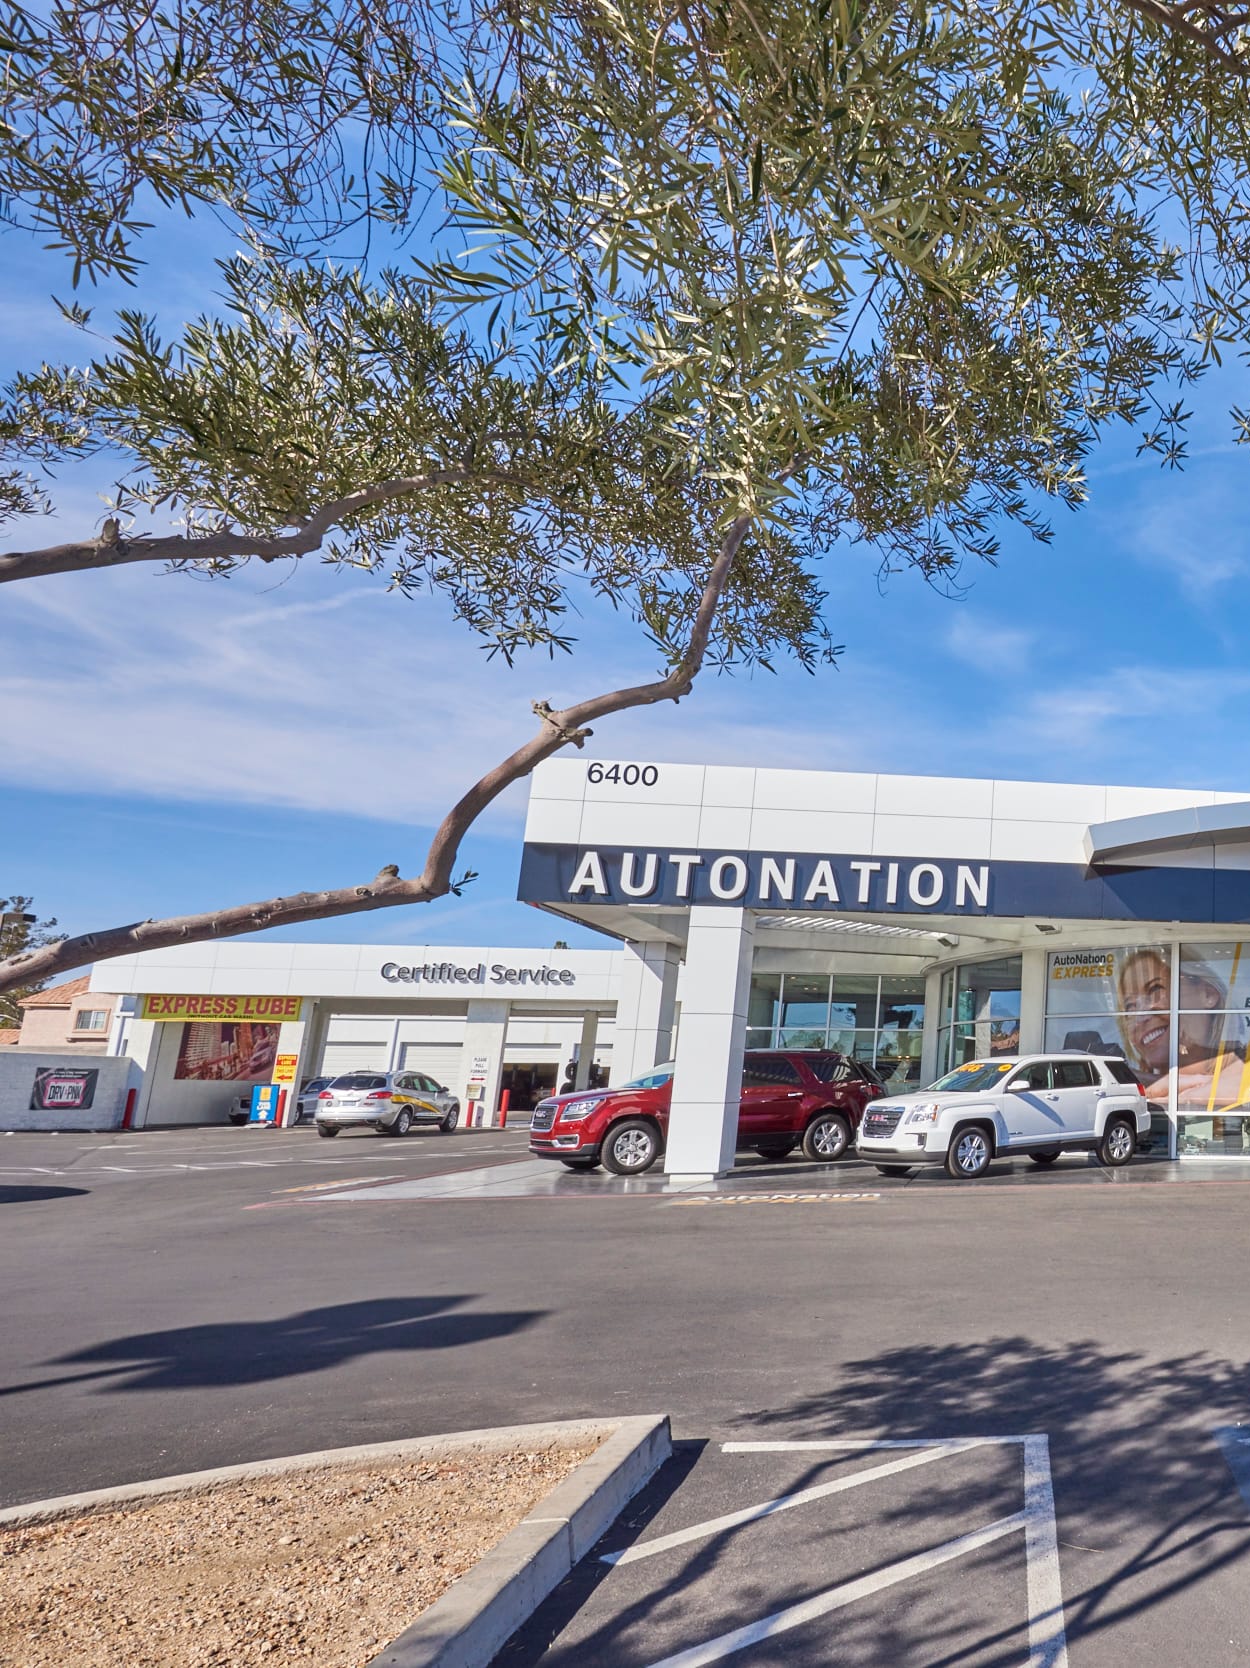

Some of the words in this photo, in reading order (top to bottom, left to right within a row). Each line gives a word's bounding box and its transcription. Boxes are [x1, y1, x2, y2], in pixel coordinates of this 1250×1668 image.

[587, 763, 659, 787] 6400
[568, 850, 990, 907] AUTONATION
[1053, 953, 1106, 966] AutoNation
[381, 962, 484, 984] Certified
[489, 964, 574, 985] Service
[1053, 964, 1114, 979] EXPRESS
[148, 996, 238, 1015] EXPRESS
[243, 997, 298, 1016] LUBE
